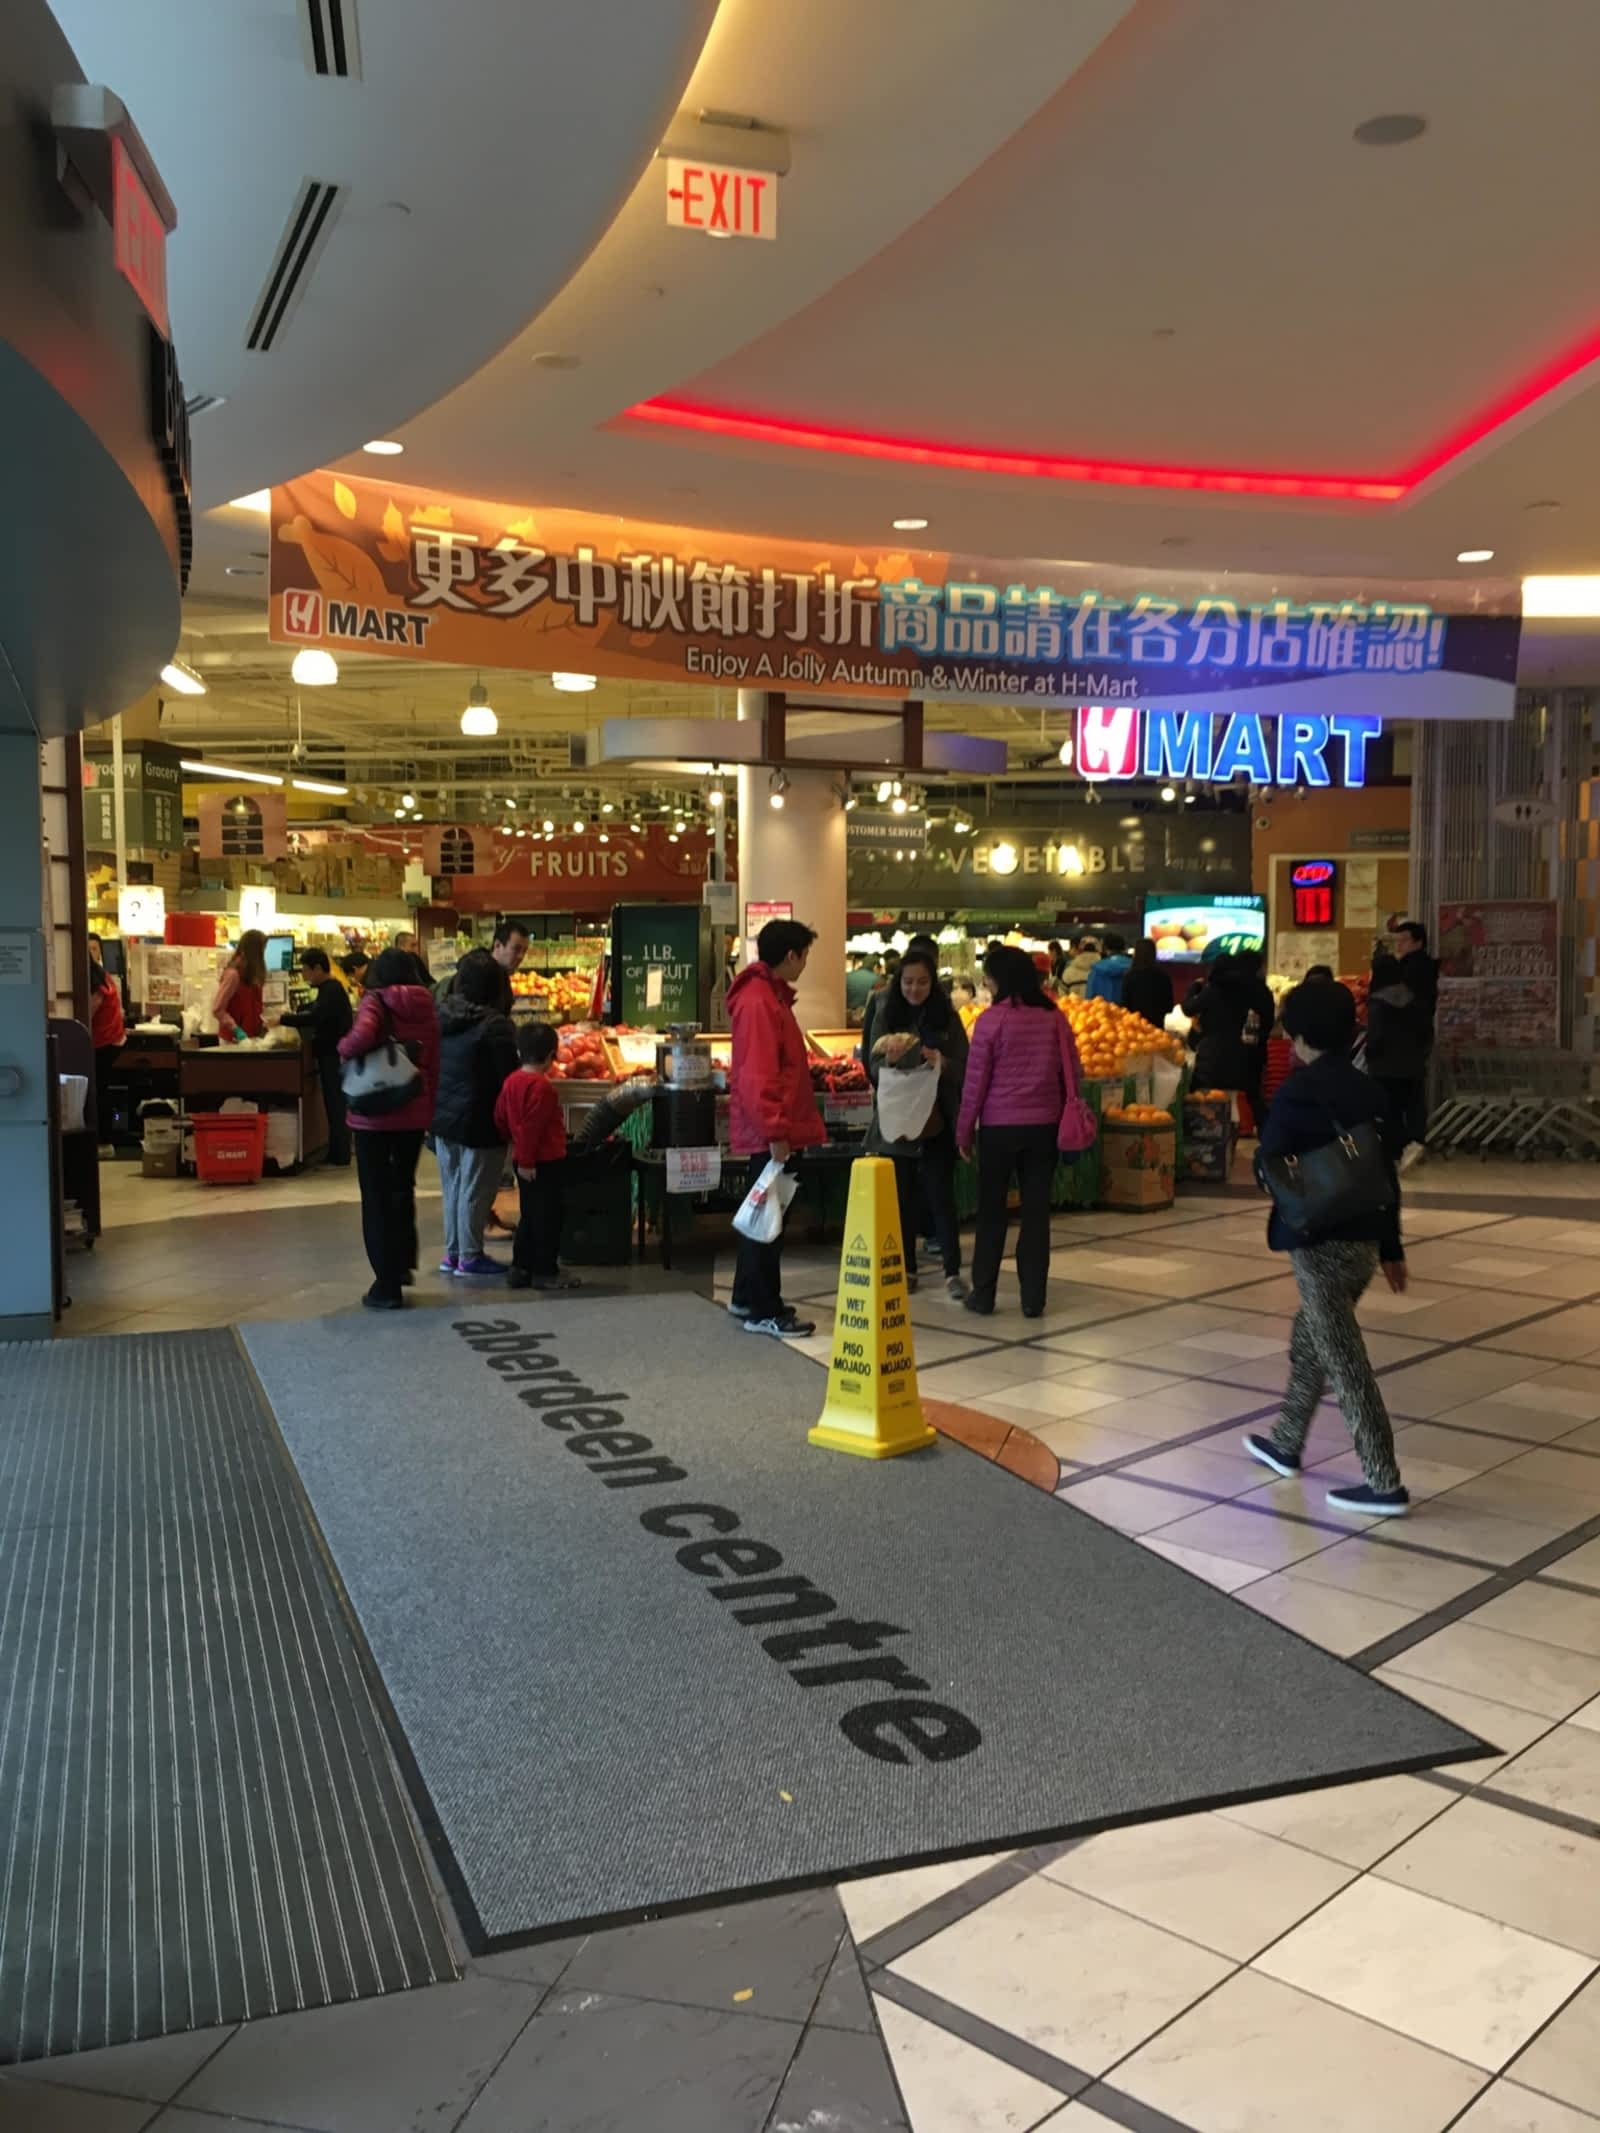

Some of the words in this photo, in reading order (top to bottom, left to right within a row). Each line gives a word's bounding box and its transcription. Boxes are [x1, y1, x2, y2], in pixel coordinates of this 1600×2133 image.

[683, 167, 767, 235] EXIT
[329, 602, 430, 646] MART
[687, 646, 749, 679] Enjoy
[755, 653, 774, 677] A
[779, 653, 826, 684] Jolly
[832, 658, 924, 688] Autumn
[931, 665, 948, 689] &
[954, 667, 1028, 693] Winter
[1034, 674, 1055, 695] at
[1062, 672, 1138, 698] H-Mart
[1145, 710, 1382, 787] MART
[145, 761, 178, 784] Grocery
[530, 851, 628, 877] FRUITS
[626, 966, 643, 978] OF
[846, 1254, 871, 1269] CAUTION
[846, 1297, 866, 1312] WET
[885, 1297, 900, 1312] WET
[840, 1313, 869, 1330] FLOOR
[881, 1313, 905, 1331] FLOOR
[843, 1341, 863, 1357] PISO
[886, 1341, 903, 1358] PISO
[833, 1357, 871, 1376] MOJADO
[880, 1357, 911, 1377] MOJADO
[451, 1318, 688, 1489] aberdeen
[639, 1502, 982, 1766] centre
